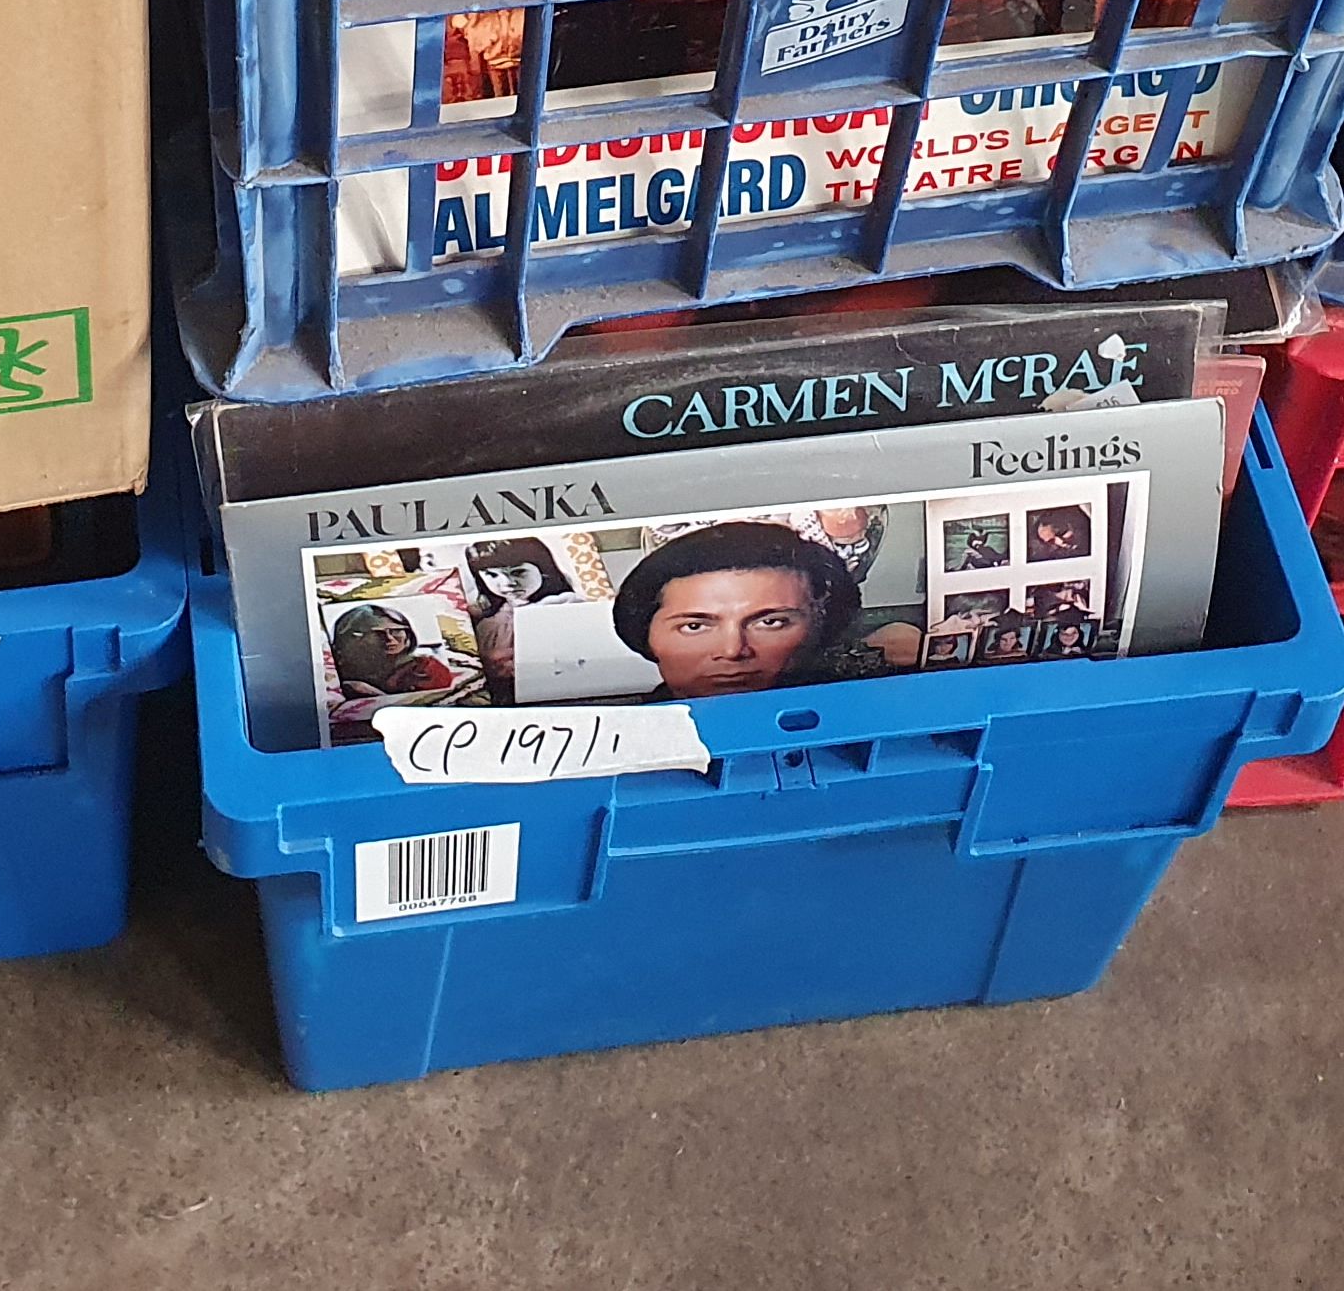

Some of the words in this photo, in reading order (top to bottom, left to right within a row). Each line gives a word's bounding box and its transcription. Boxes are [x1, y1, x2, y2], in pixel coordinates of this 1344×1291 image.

[777, 17, 891, 62] Farmers
[799, 9, 875, 42] Dairy
[1025, 110, 1210, 146] LARGET
[826, 159, 1023, 203] THATRE
[432, 192, 506, 256] AL
[623, 366, 913, 439] CARMEN
[969, 434, 1142, 478] Feelings
[307, 499, 450, 543] PAUL
[459, 481, 616, 529] ANKA
[409, 719, 478, 776] CP
[500, 715, 621, 777] 197/1
